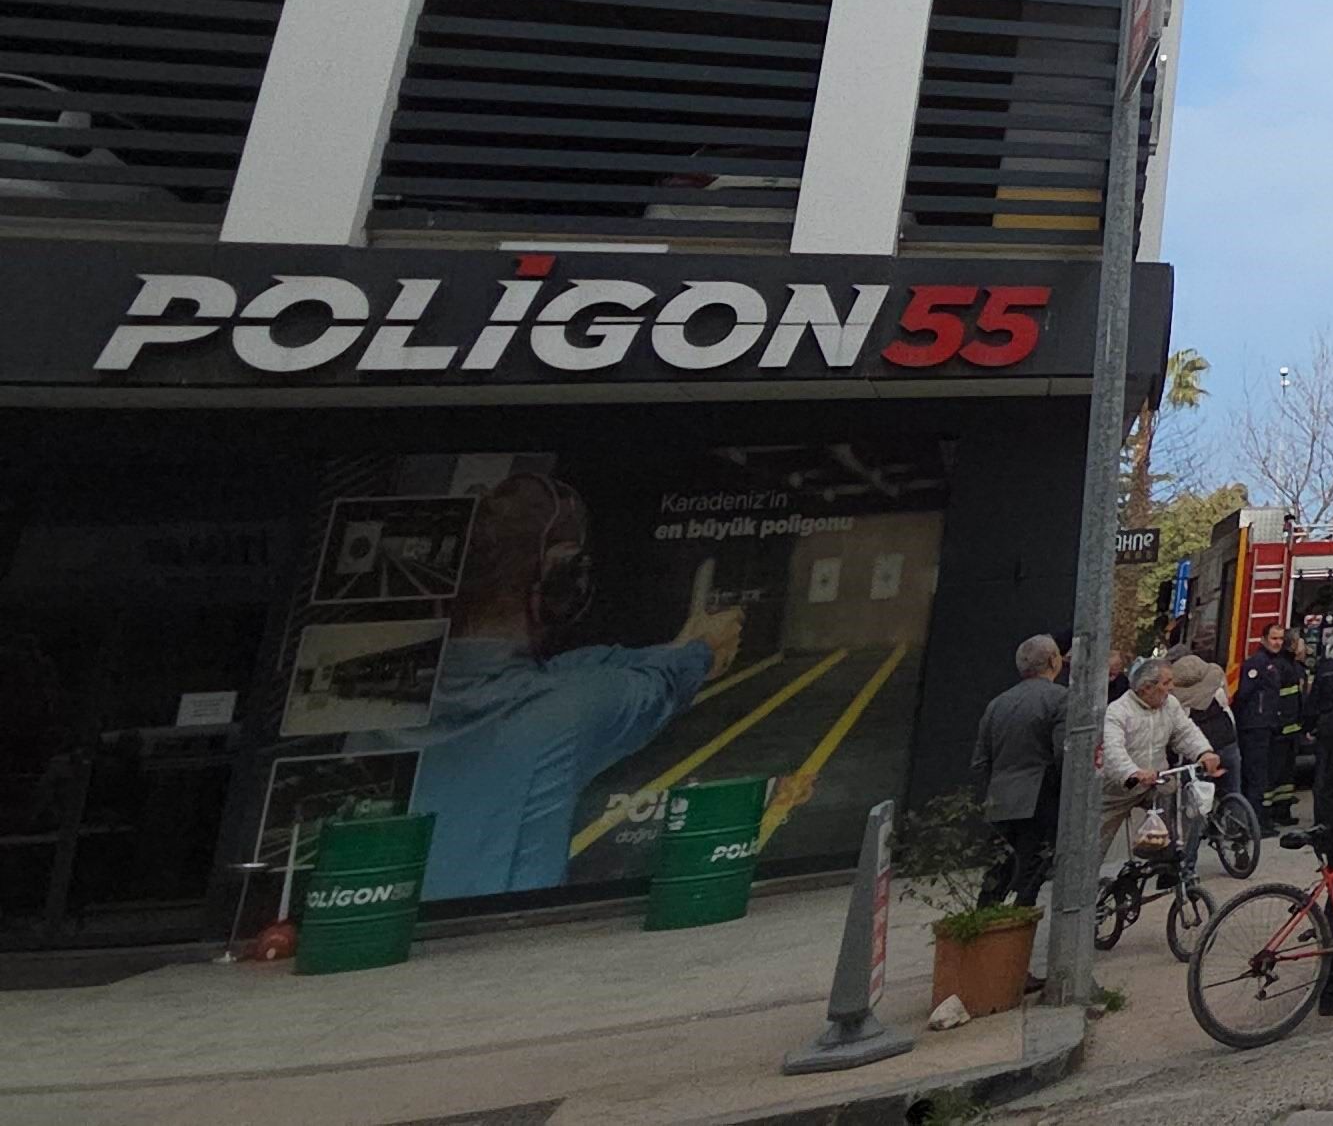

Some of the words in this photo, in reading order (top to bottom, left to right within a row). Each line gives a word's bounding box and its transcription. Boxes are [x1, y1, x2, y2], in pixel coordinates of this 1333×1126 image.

[92, 255, 890, 373] POLİGON
[880, 285, 1052, 369] 55
[655, 523, 683, 540] en
[686, 516, 755, 541] büyük
[760, 514, 854, 539] poligonu
